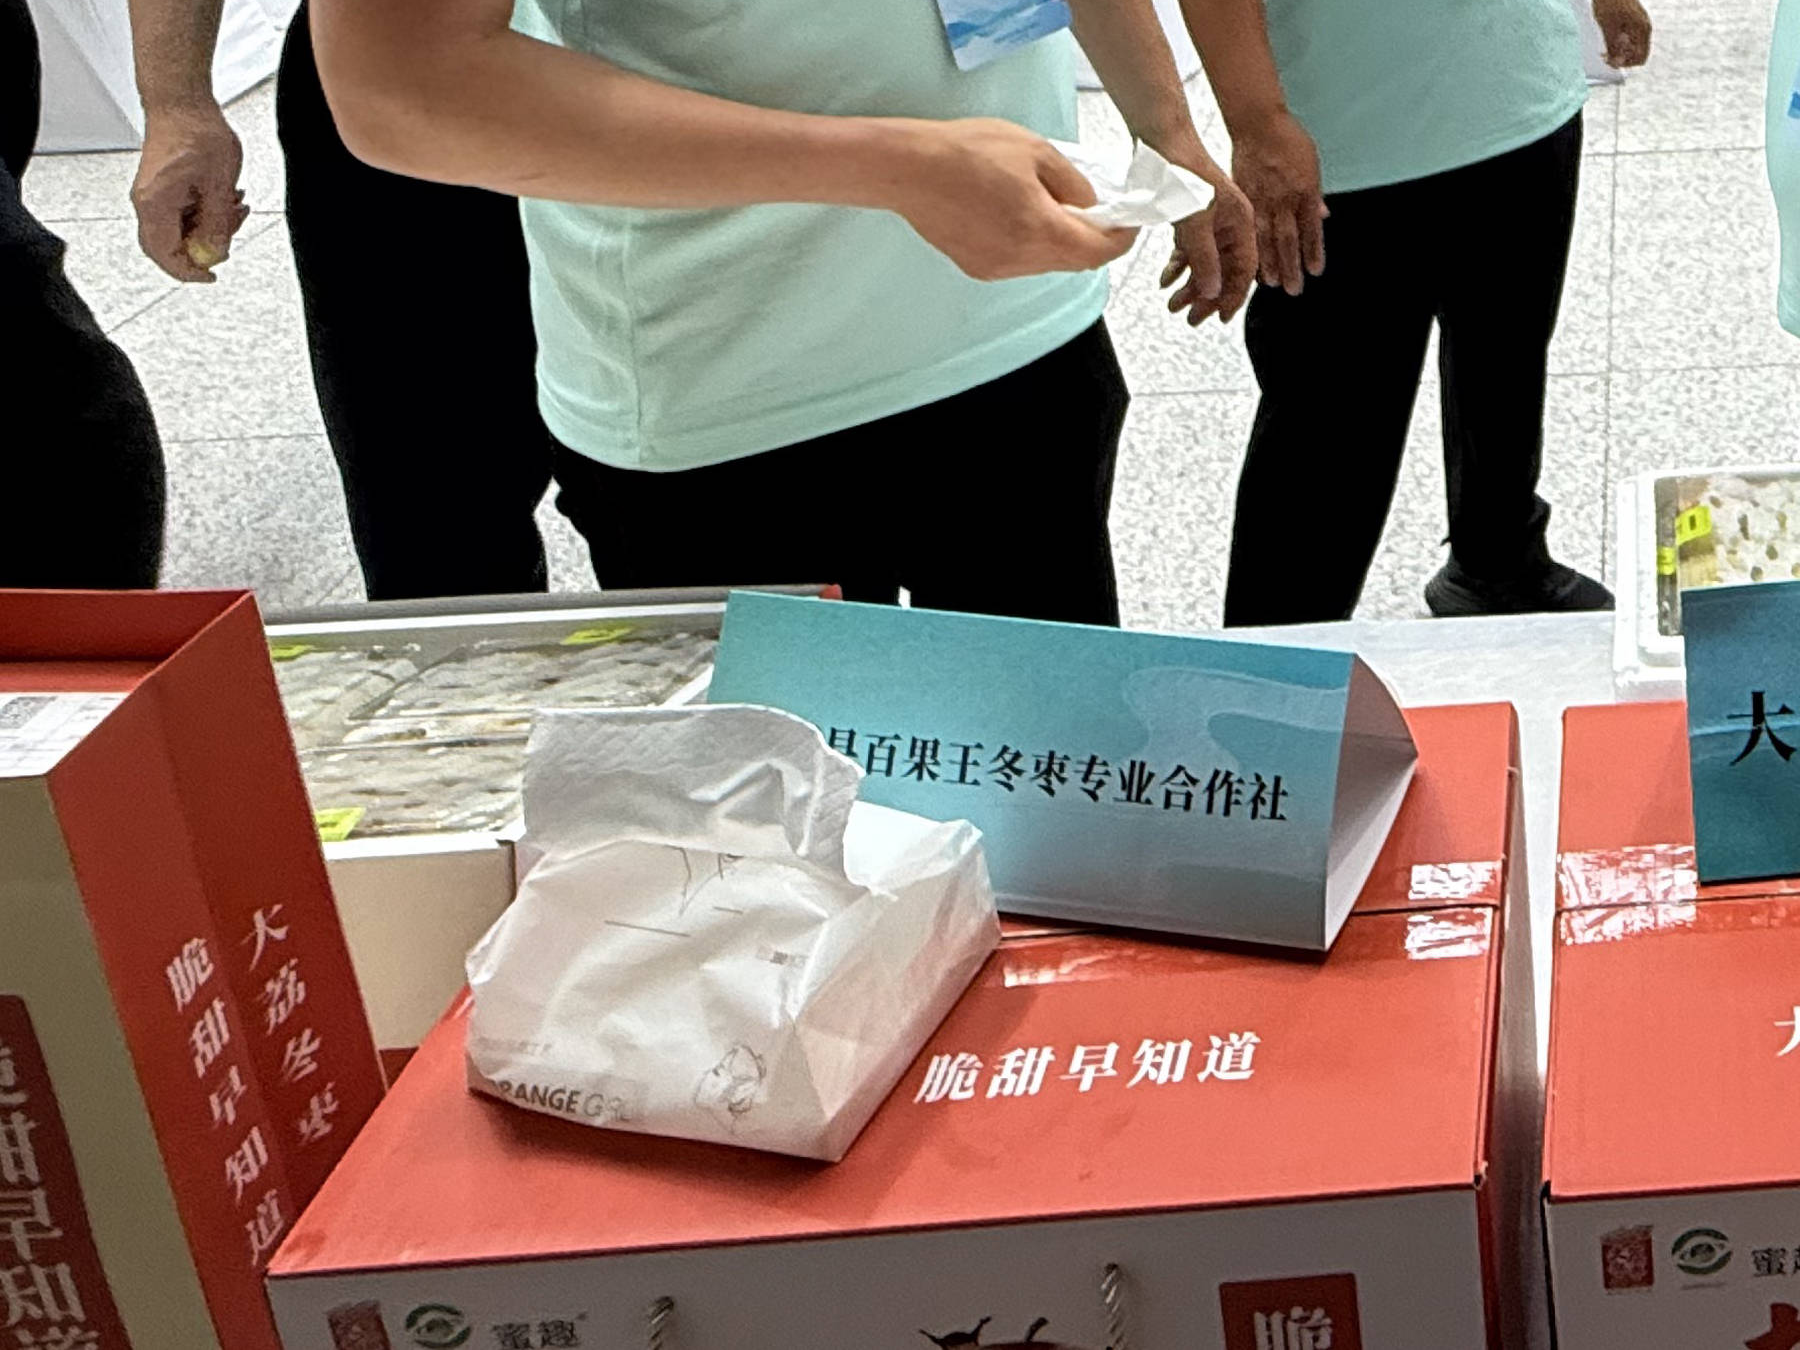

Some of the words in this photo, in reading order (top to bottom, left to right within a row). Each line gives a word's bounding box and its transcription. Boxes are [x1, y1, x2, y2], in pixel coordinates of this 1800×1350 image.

[826, 726, 1289, 822] 县百果王冬枣专业合作社
[166, 936, 286, 1267] 脆甜早知道
[241, 902, 340, 1145] 大荔冬枣
[912, 1030, 1263, 1107] 脆甜早知道
